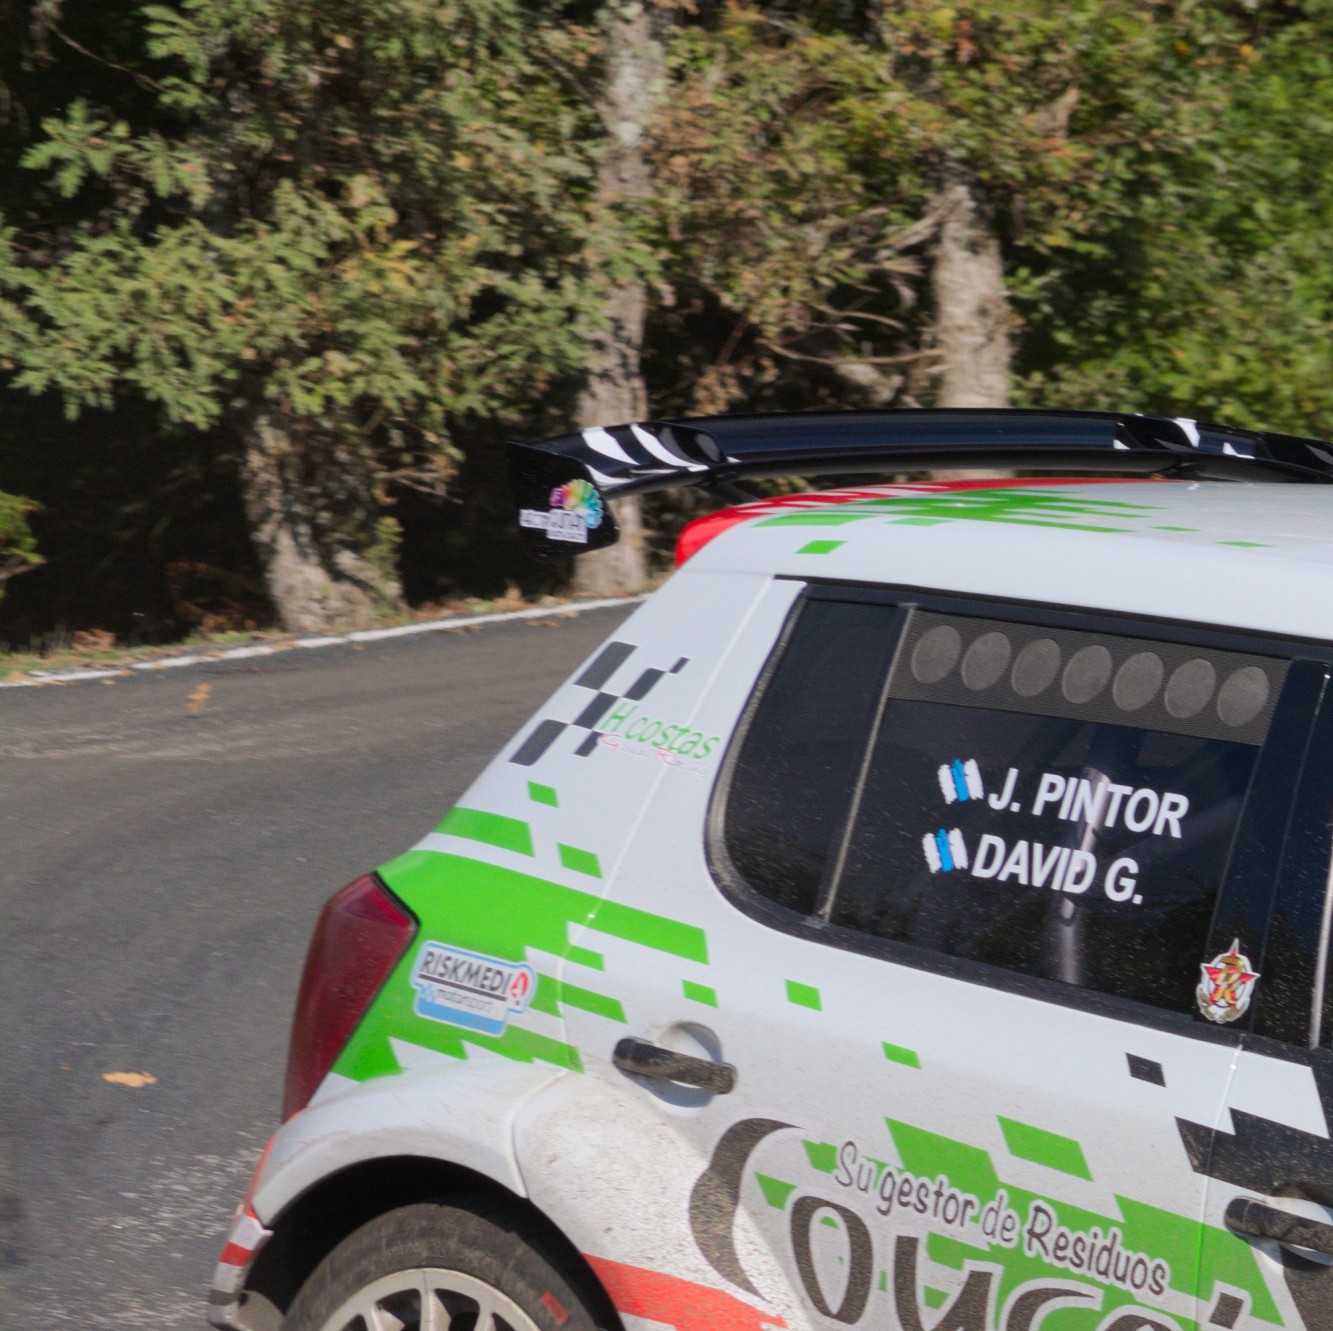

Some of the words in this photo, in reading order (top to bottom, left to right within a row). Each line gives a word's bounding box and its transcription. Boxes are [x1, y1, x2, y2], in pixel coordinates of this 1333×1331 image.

[988, 767, 1021, 812] J.
[1031, 773, 1189, 839] PINTOR
[971, 834, 1097, 894] DAVID
[1104, 857, 1143, 905] G.
[835, 1141, 876, 1189] Su
[877, 1171, 979, 1233] gestor
[982, 1195, 1017, 1240] de
[1027, 1205, 1168, 1296] Residuos
